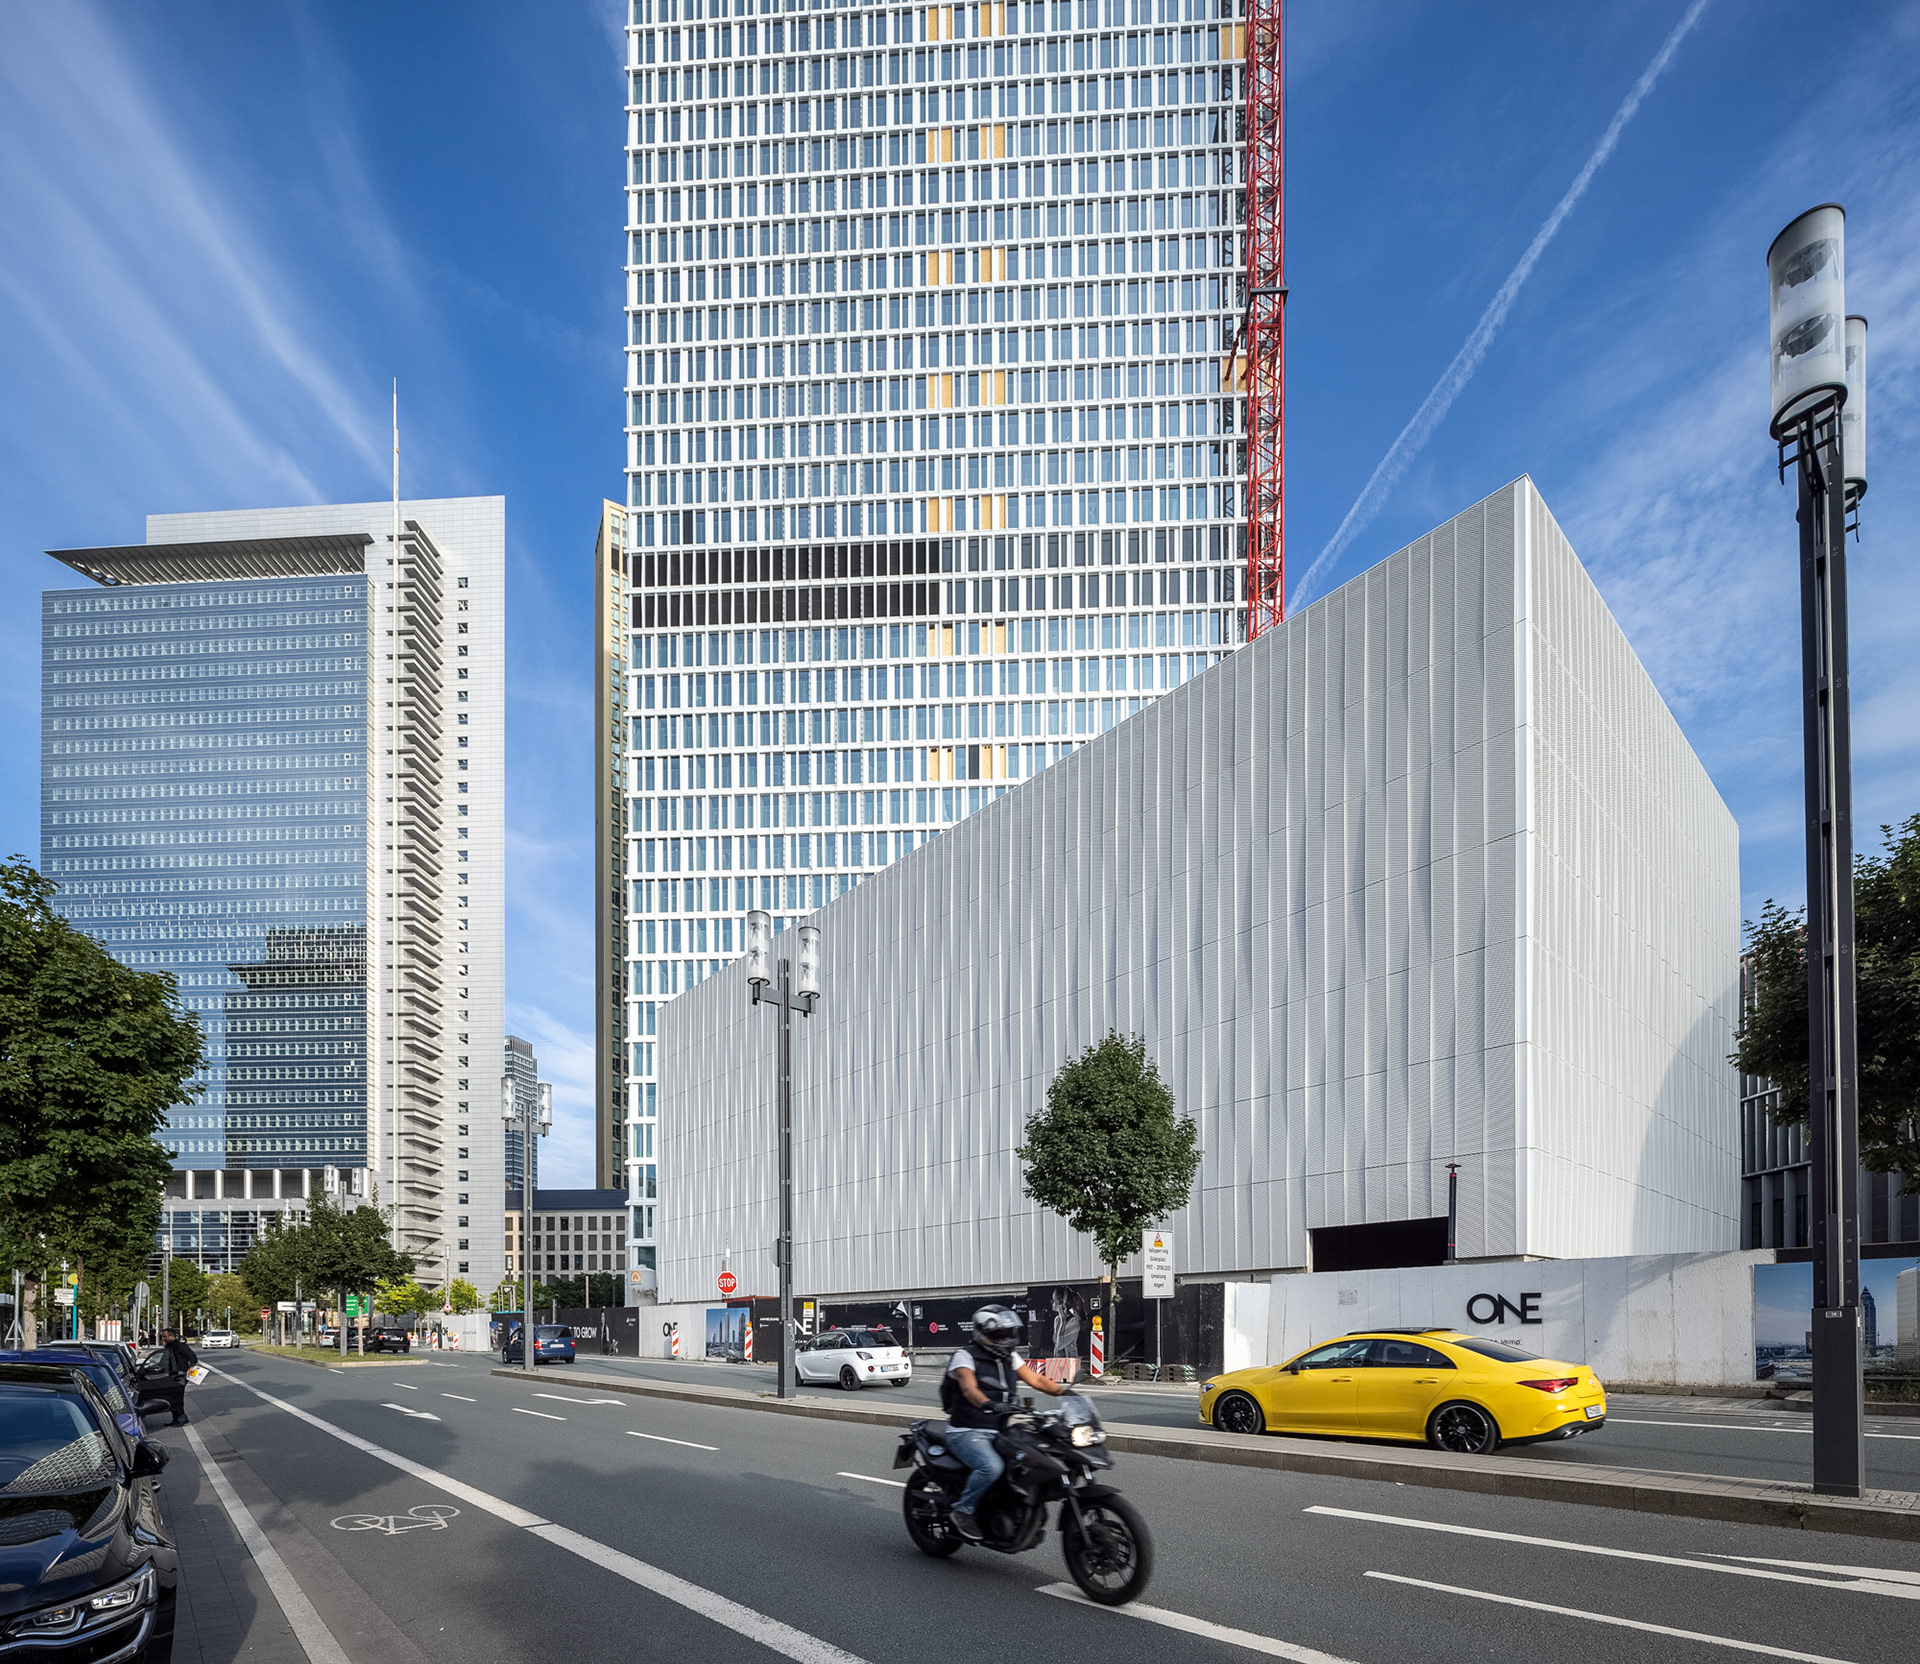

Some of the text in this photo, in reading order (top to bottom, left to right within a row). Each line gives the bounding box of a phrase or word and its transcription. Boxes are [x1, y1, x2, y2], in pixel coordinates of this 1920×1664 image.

[719, 1278, 736, 1288] STOP
[1466, 1293, 1542, 1324] ONE
[573, 1326, 597, 1338] TO GROW
[794, 1318, 813, 1335] NE
